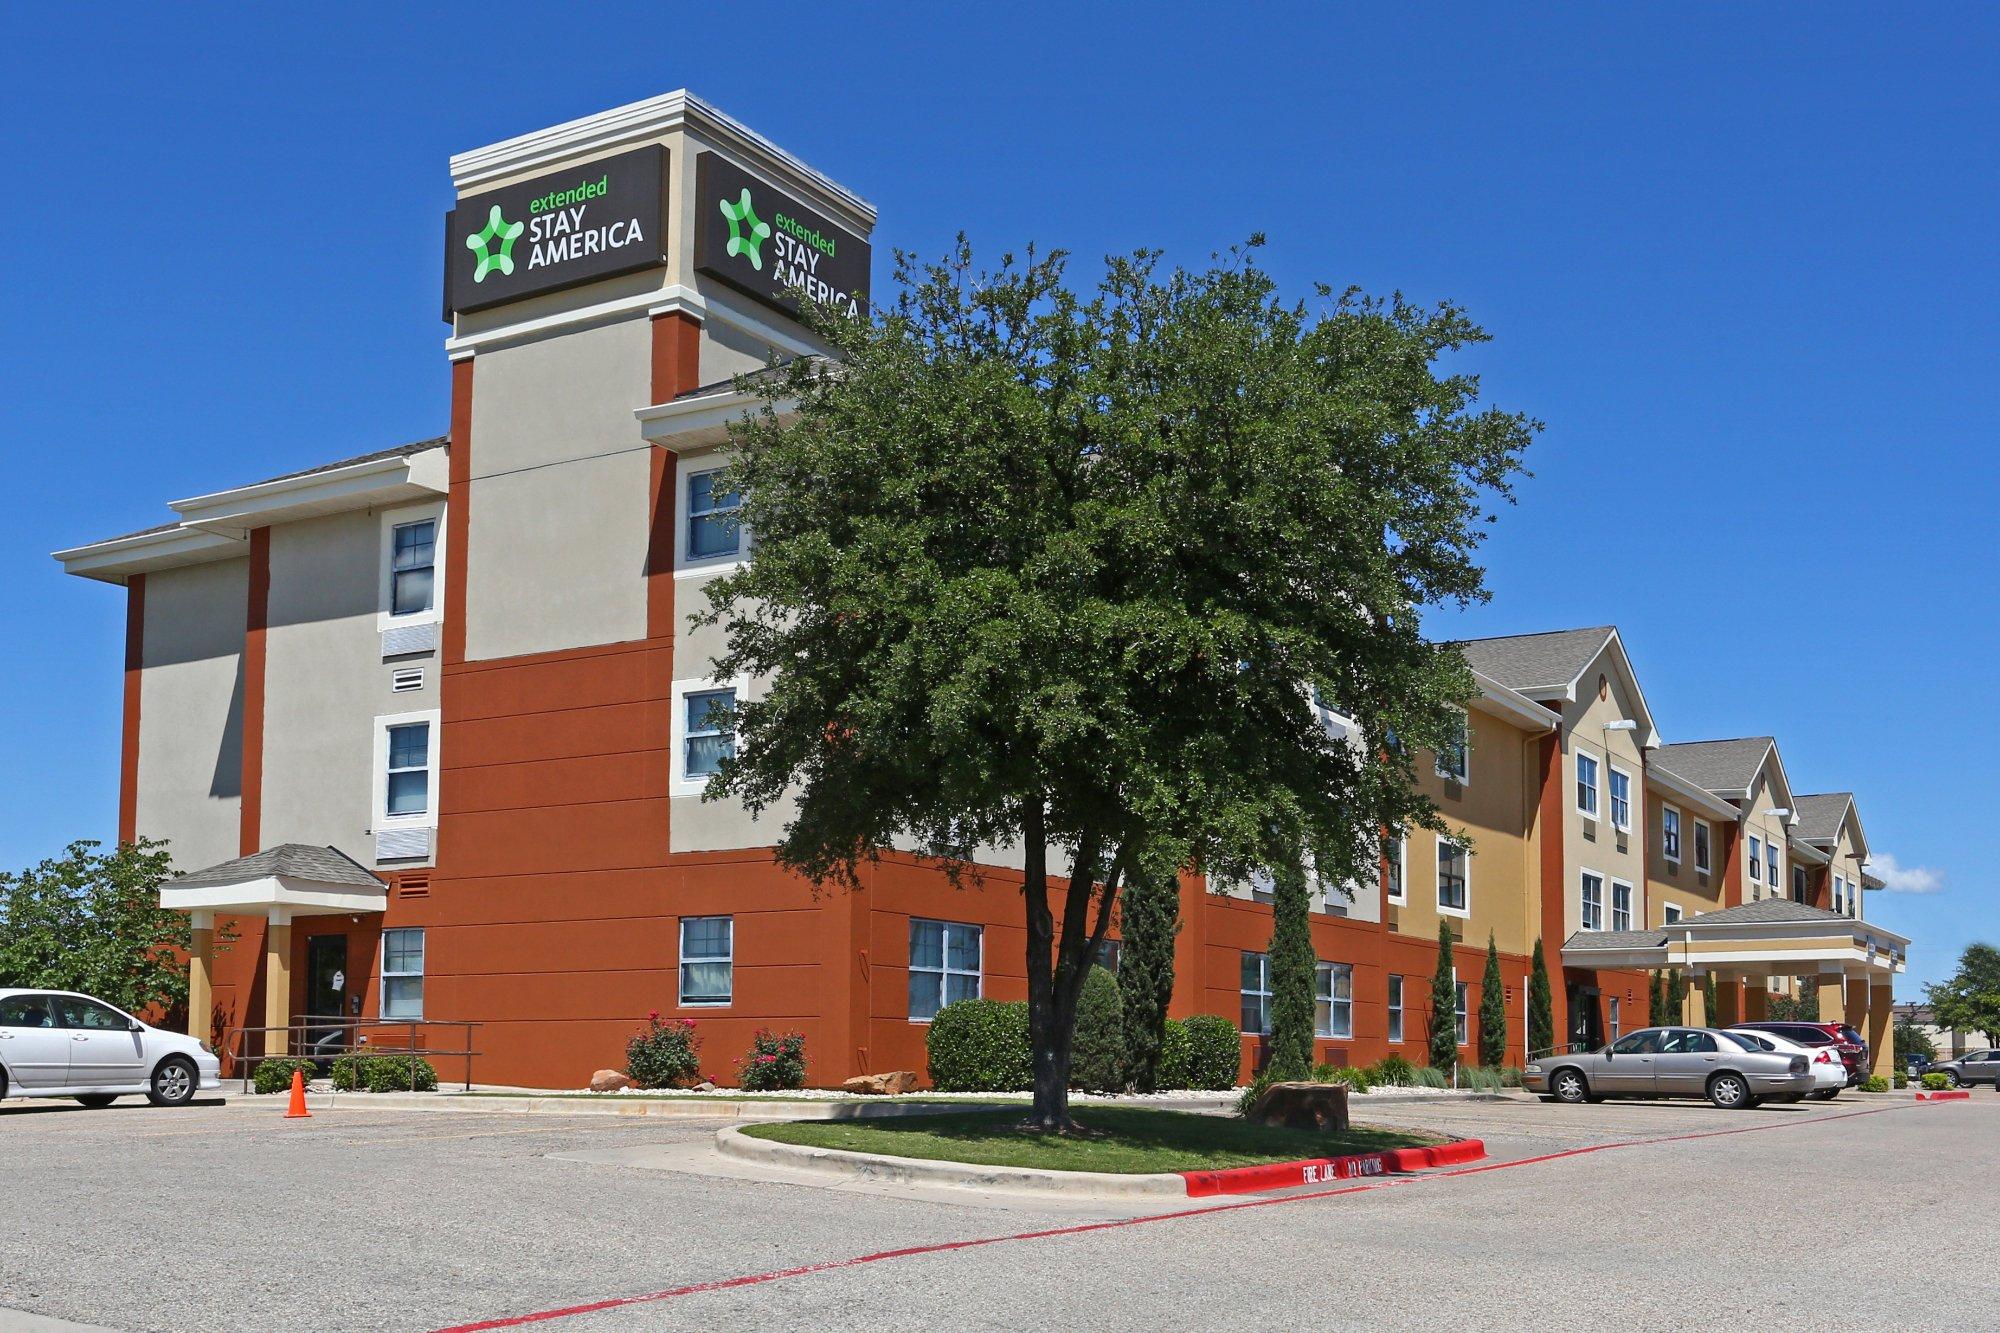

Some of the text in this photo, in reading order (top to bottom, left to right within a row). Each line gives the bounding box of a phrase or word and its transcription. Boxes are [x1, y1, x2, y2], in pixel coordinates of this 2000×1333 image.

[530, 175, 608, 214] extended
[527, 217, 644, 270] AMERICA
[529, 204, 588, 243] STAY
[775, 212, 835, 257] extended
[774, 231, 820, 275] STAY
[1302, 1165, 1319, 1184] FIRE
[1320, 1163, 1338, 1182] LANE
